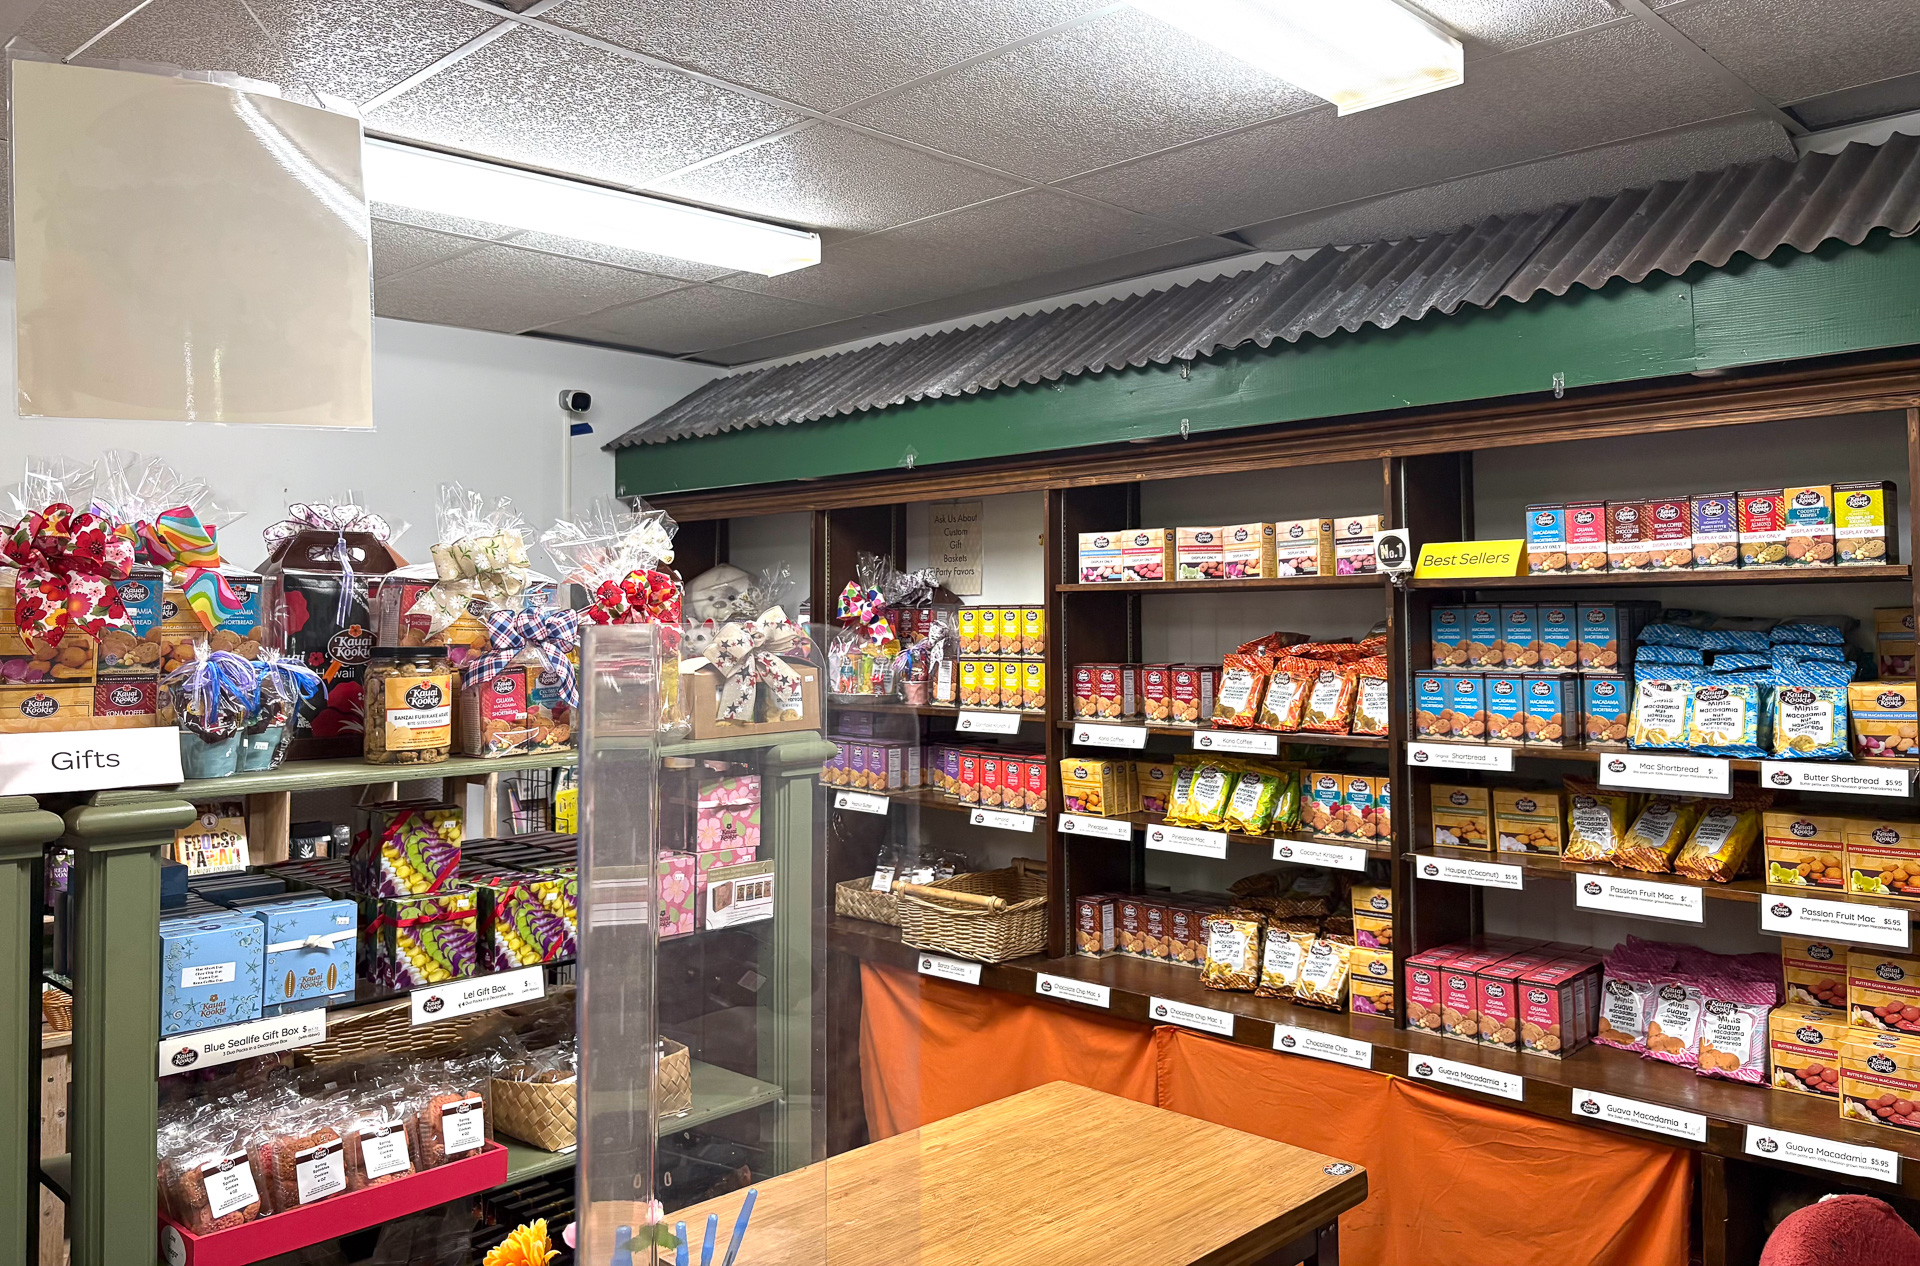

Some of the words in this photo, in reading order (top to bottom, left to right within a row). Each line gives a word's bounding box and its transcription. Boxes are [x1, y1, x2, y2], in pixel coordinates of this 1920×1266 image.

[944, 528, 968, 536] Custom
[950, 541, 962, 549] Gift
[1380, 543, 1403, 560] No.1
[944, 554, 967, 563] Baskets
[1423, 554, 1456, 567] Best
[1460, 552, 1510, 565] Sellers
[936, 568, 952, 577] Party
[123, 586, 144, 595] Kauai
[120, 592, 145, 601] Kookie
[335, 636, 372, 649] Kauai
[410, 688, 437, 698] Kauai
[112, 694, 138, 703] Kookie
[408, 696, 439, 707] Kookie
[1881, 695, 1900, 703] Kauai
[27, 700, 53, 709] Kauai
[24, 705, 55, 714] Kookie
[51, 750, 120, 770] Gifts
[1452, 753, 1486, 761] Shortbread
[1657, 764, 1699, 773] Shortbread
[1804, 774, 1829, 782] Butter
[1832, 775, 1879, 785] Shortbread
[1088, 823, 1108, 831] Pineapple
[184, 832, 229, 851] FOODS
[1172, 834, 1194, 842] Pineapple
[1875, 835, 1896, 843] Kookie
[1300, 849, 1322, 857] Coconut
[1445, 867, 1466, 875] Haupia
[1468, 869, 1499, 879] (Coconut)
[1610, 886, 1637, 895] Passion
[1802, 908, 1833, 918] Passion
[1836, 912, 1854, 920] Fruit
[1858, 914, 1875, 923] Mac
[1880, 965, 1900, 973] Kauai
[299, 980, 324, 990] Kookie
[1054, 983, 1076, 993] Chocolate
[1076, 987, 1086, 995] Chip
[477, 987, 490, 997] Gift
[492, 985, 506, 994] Box
[200, 999, 226, 1010] Kauai
[1615, 996, 1634, 1004] Minis
[198, 1008, 226, 1018] Kookie
[1170, 1008, 1194, 1019] Chocolate
[1195, 1013, 1206, 1021] Chip
[1667, 1008, 1687, 1016] Guava
[1800, 1034, 1820, 1042] Kookie
[1802, 1030, 1818, 1038] Kauai
[204, 1043, 225, 1053] Blue
[228, 1034, 260, 1049] Sealife
[263, 1030, 279, 1041] Gift
[282, 1027, 299, 1037] Box
[1306, 1038, 1333, 1050] Chocolate
[1335, 1045, 1348, 1053] Chip
[1873, 1058, 1892, 1066] Kauai
[1871, 1063, 1894, 1072] Kookie
[1438, 1067, 1459, 1077] Guava
[1461, 1071, 1499, 1085] Macadamia
[1879, 1078, 1907, 1086] MACADAMIA
[1607, 1104, 1631, 1116] Guava
[1633, 1110, 1678, 1127] Macadamia
[1786, 1142, 1813, 1153] Guava
[1816, 1148, 1867, 1163] Macadamia
[1871, 1158, 1889, 1167] $5.95
